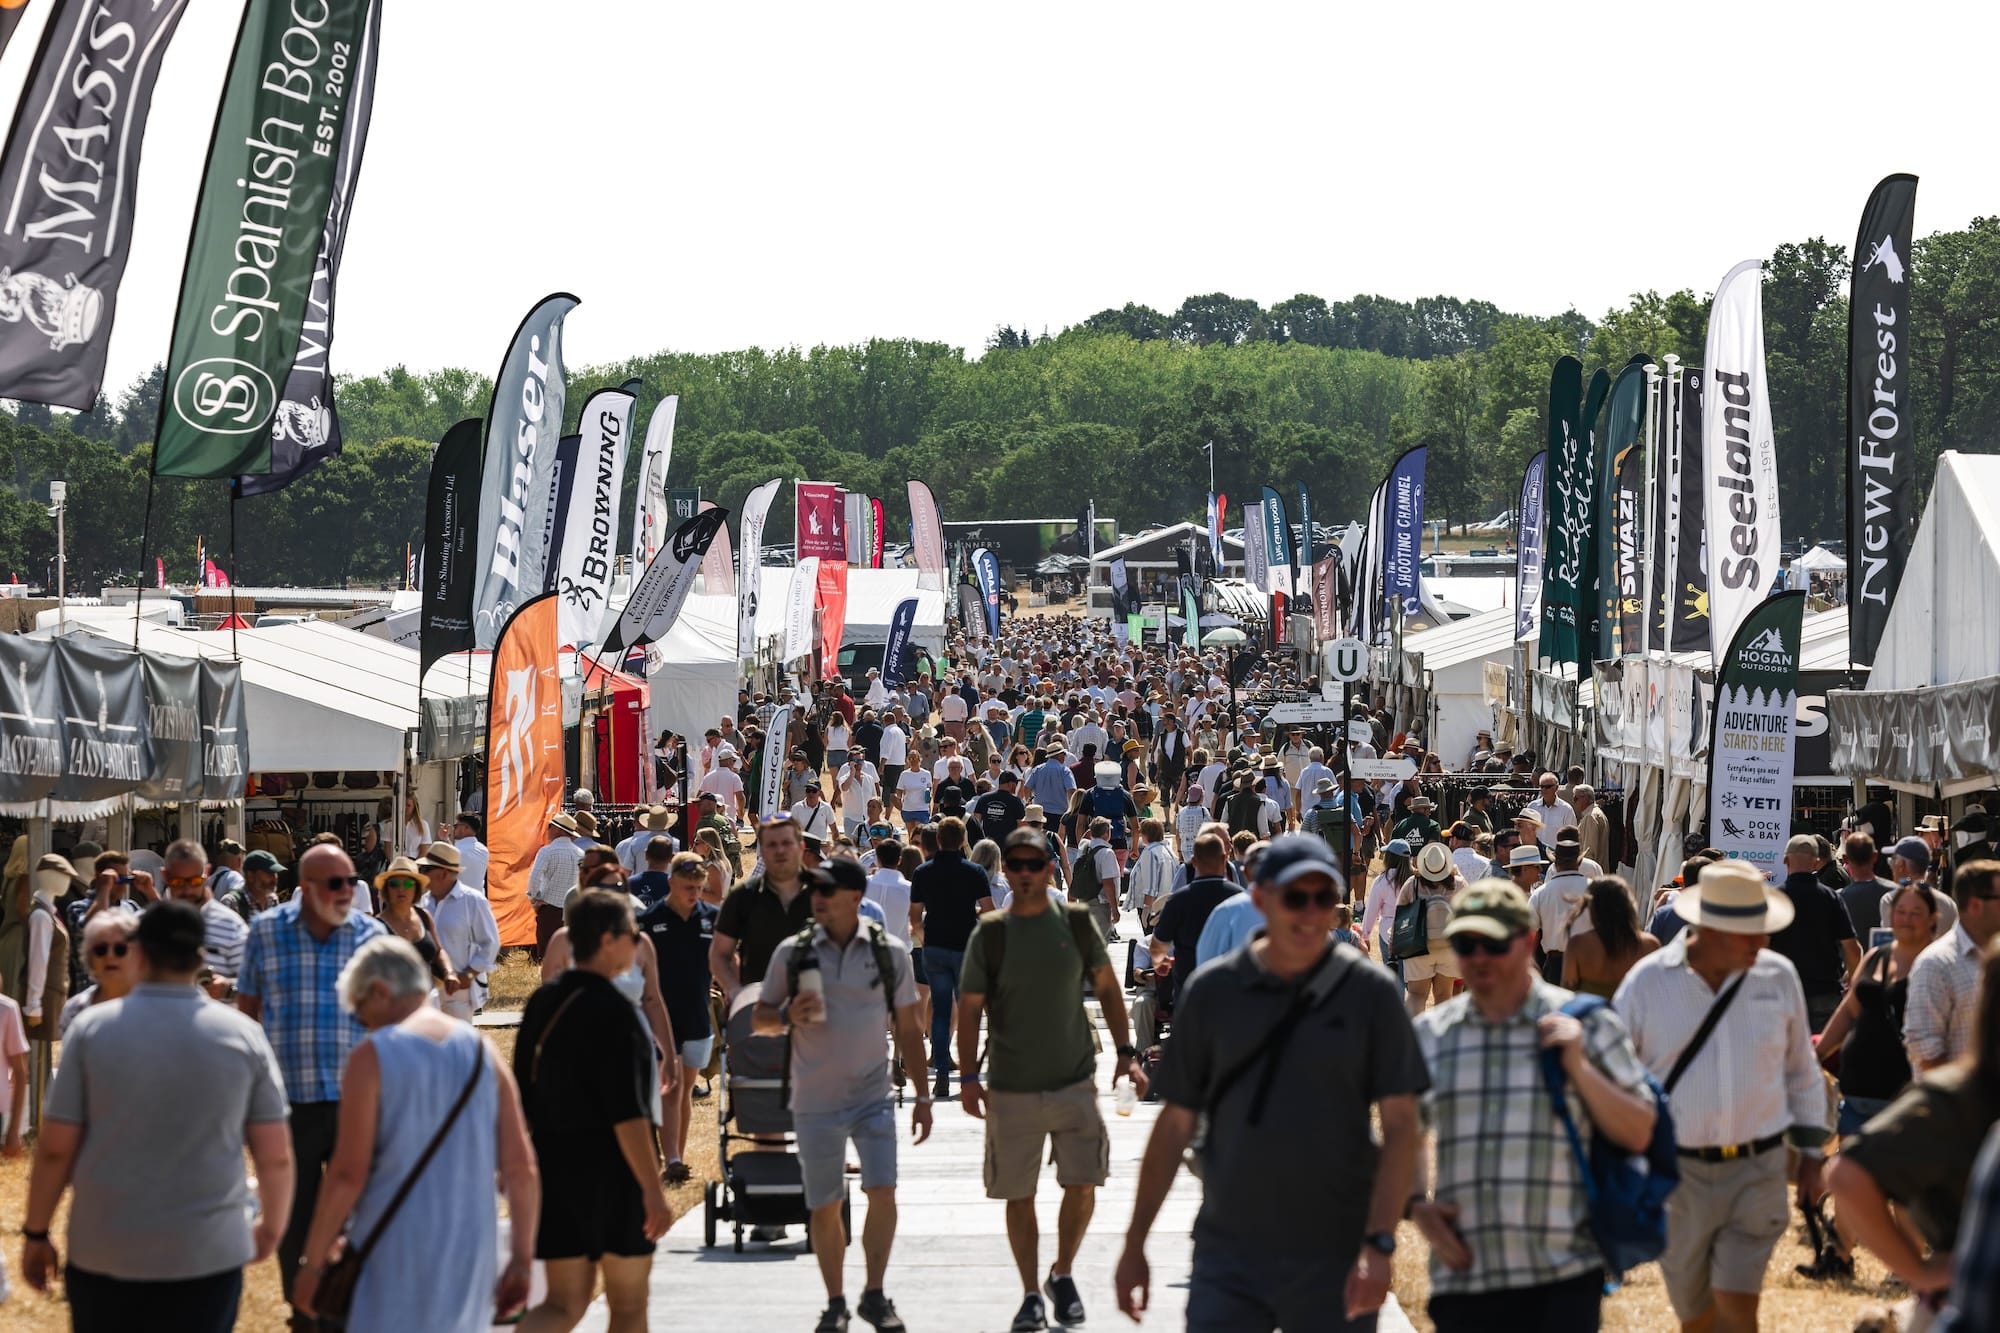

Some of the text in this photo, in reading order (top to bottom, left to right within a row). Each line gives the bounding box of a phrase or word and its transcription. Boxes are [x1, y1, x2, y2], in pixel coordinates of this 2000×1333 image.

[312, 41, 350, 157] EST. 2002
[23, 0, 160, 254] MASS
[210, 117, 304, 342] Spanish
[490, 335, 548, 590] Blaser
[1760, 440, 1771, 473] 1976
[582, 411, 623, 584] BROWNING
[1716, 368, 1759, 592] Seeland
[442, 494, 454, 541] Accessories
[1396, 475, 1412, 588] SHOOTING CHANNEL
[438, 542, 451, 583] Shooting
[1621, 490, 1636, 594] SWAZI
[436, 584, 446, 601] Fine
[791, 607, 802, 651] SWALLOW
[889, 654, 897, 674] FOR
[894, 630, 904, 654] FREE
[1338, 650, 1357, 676] U
[1738, 650, 1792, 666] HOGAN
[1741, 662, 1788, 673] OUTDOORS
[541, 666, 560, 820] SITKA
[1723, 711, 1789, 734] ADVENTURE
[1723, 732, 1786, 753] STARTS HERE
[767, 730, 782, 805] MedCert
[1727, 763, 1756, 774] Everything
[1767, 767, 1780, 775] need
[1730, 774, 1776, 785] for days outdoors
[1742, 796, 1781, 811] YETI
[1748, 831, 1780, 841] & BAY
[1749, 821, 1780, 831] DOCK
